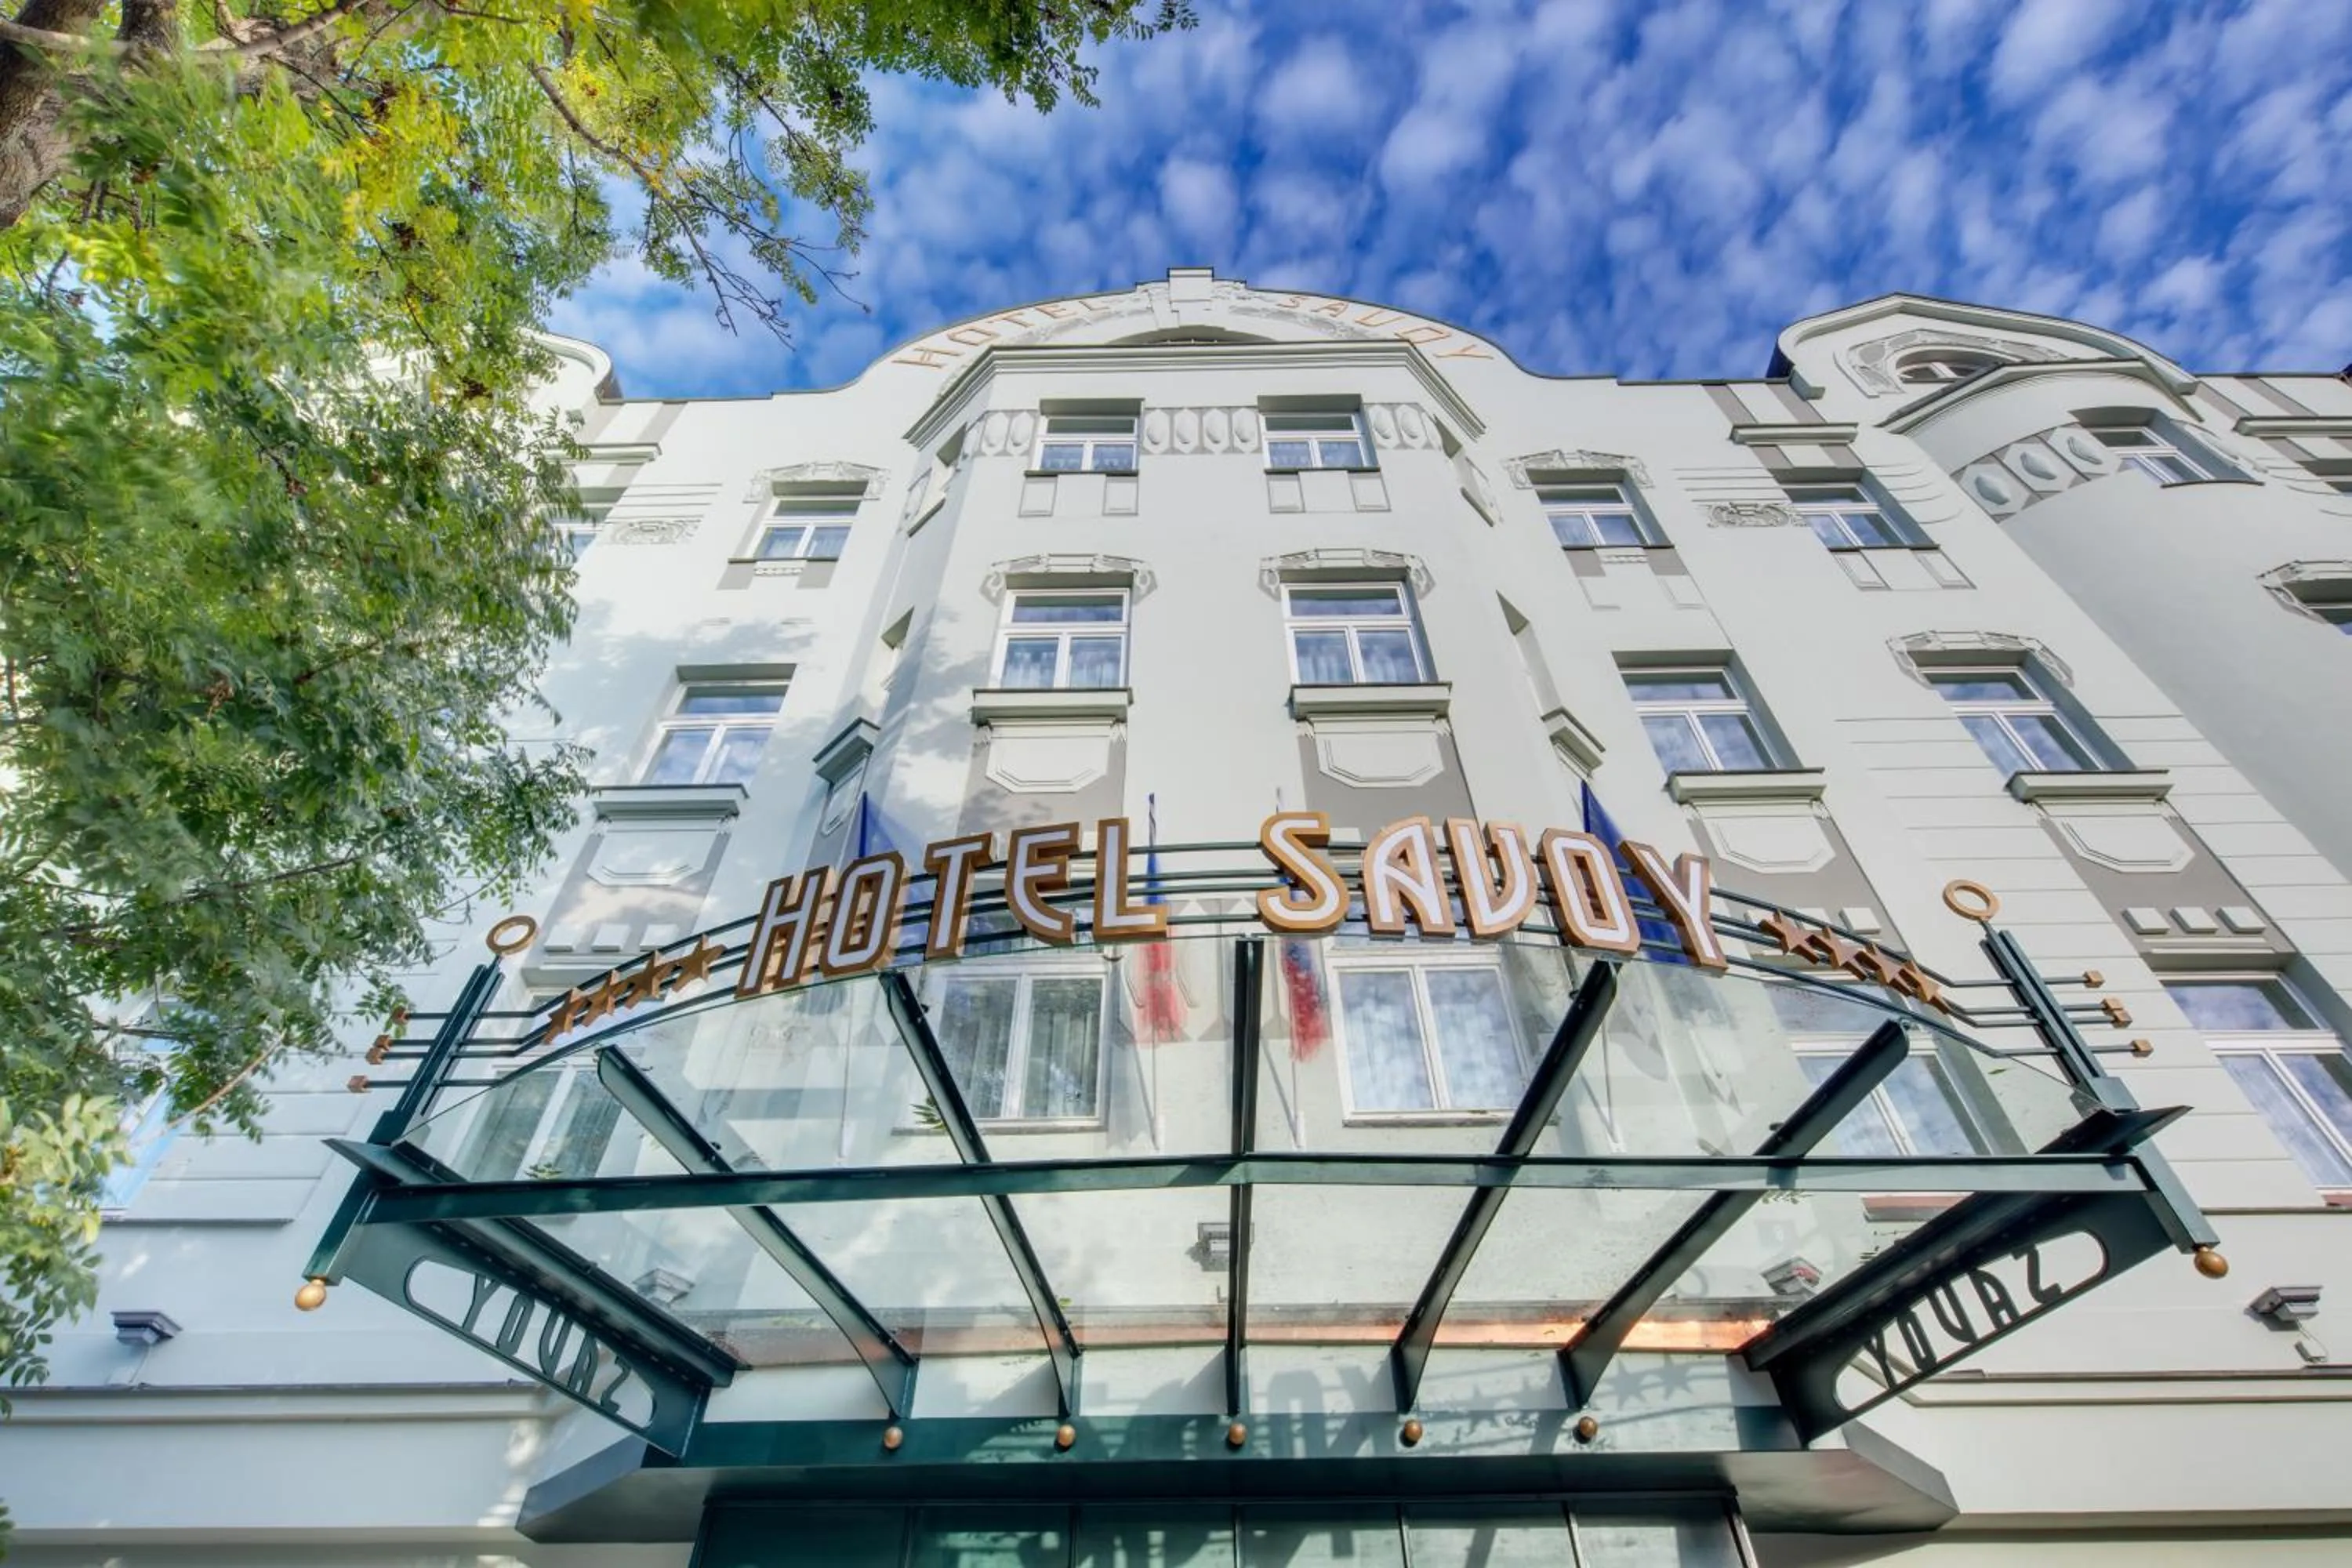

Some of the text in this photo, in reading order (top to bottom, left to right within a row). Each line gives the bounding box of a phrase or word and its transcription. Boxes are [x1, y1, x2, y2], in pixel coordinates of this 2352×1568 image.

[891, 295, 1494, 368] HOTEL SAVOY
[735, 811, 1727, 998] HOTEL SAVOY
